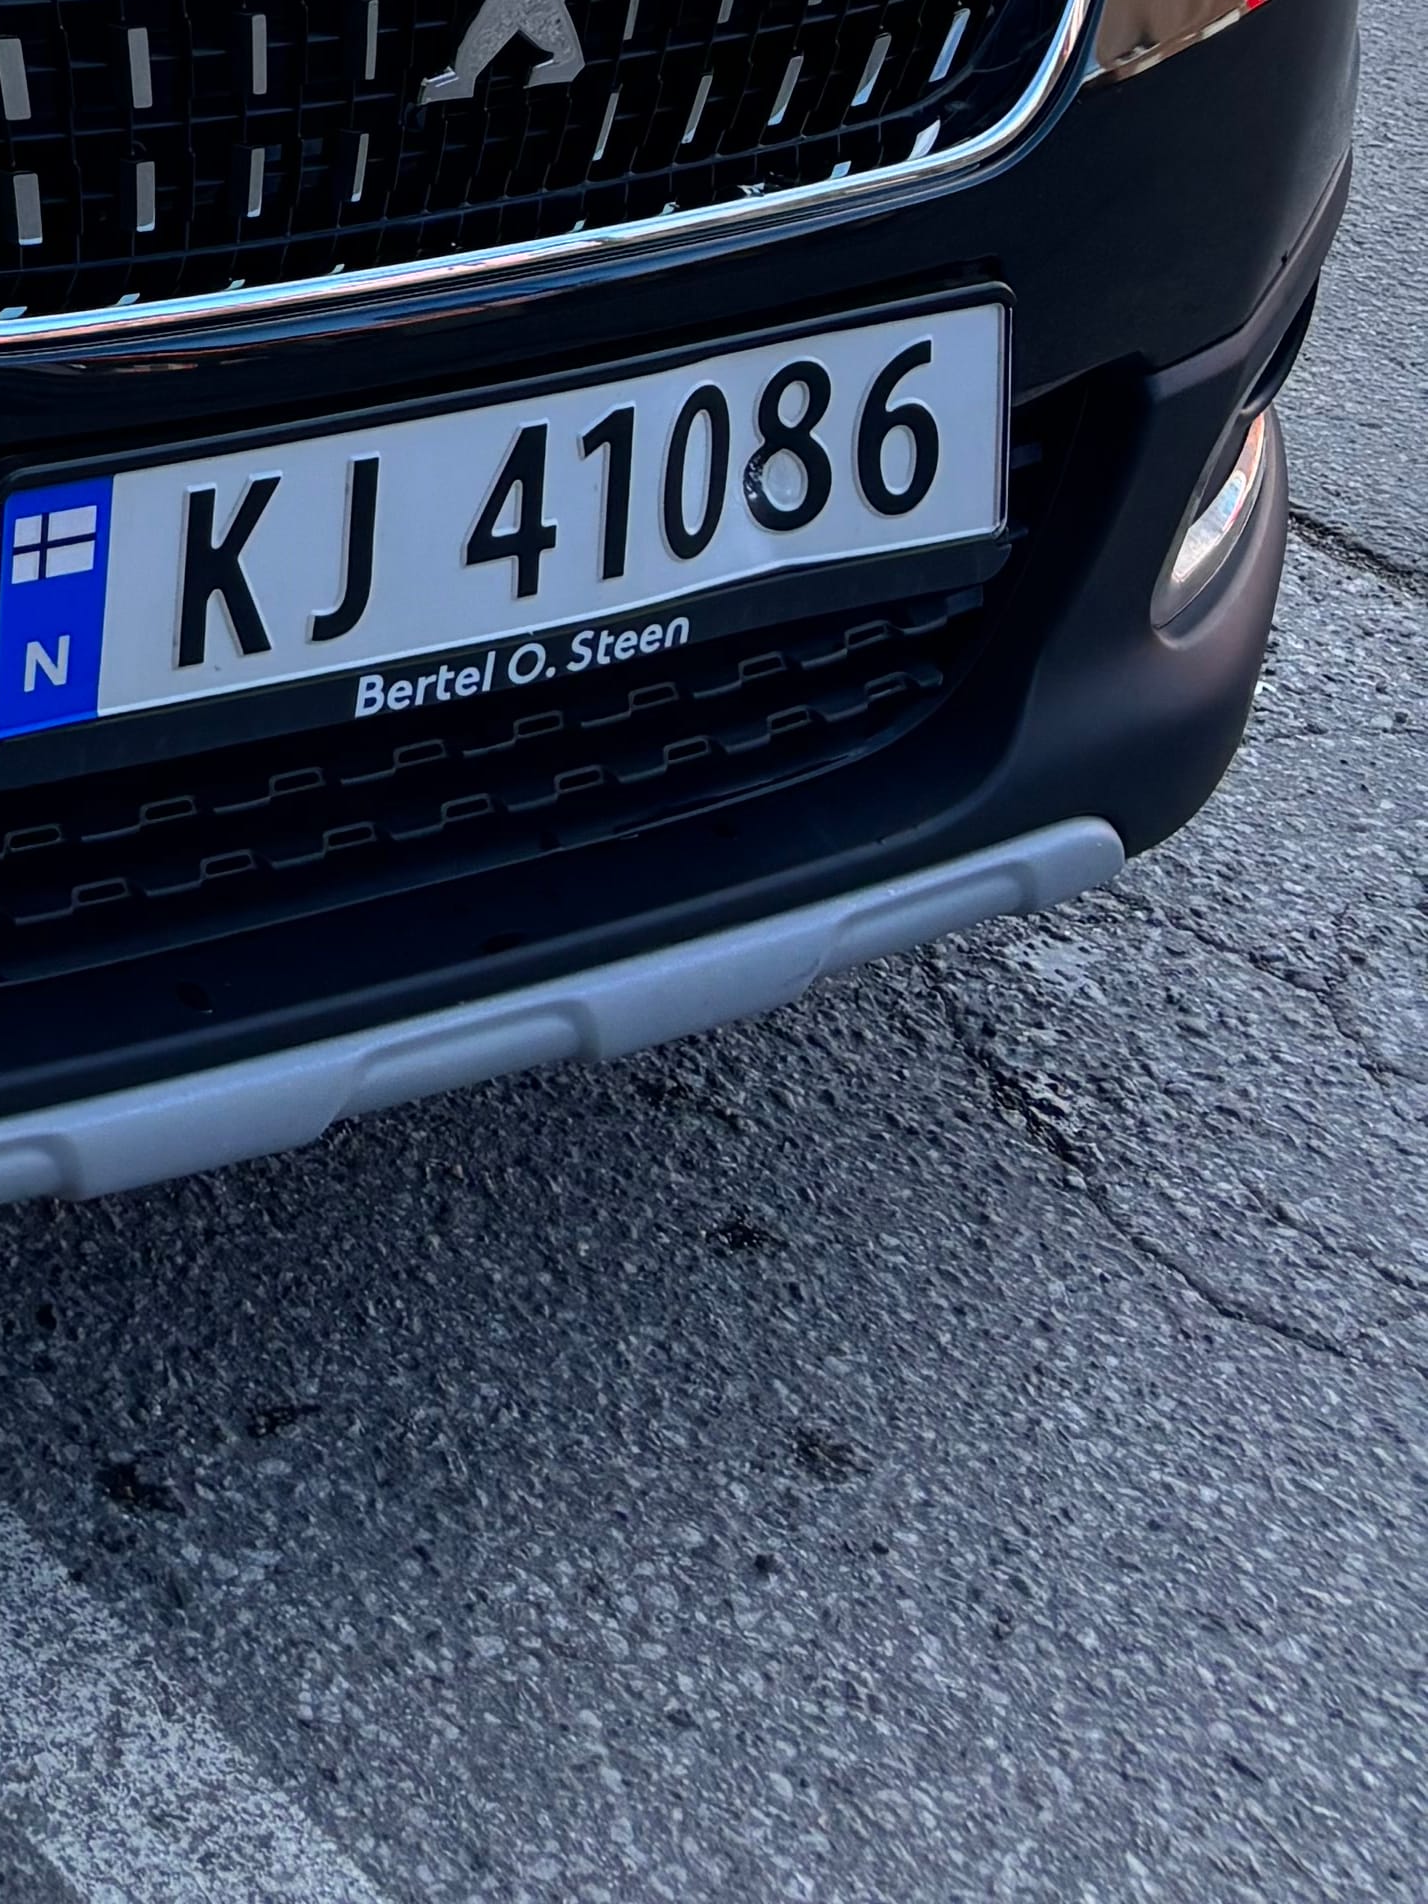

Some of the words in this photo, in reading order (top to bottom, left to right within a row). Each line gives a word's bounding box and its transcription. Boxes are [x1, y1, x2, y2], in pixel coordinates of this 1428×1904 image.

[175, 453, 381, 668] KJ
[463, 336, 940, 599] 41086
[24, 635, 70, 692] N
[355, 650, 496, 718] Bertel
[508, 643, 556, 685] O.
[566, 617, 690, 672] Steen
